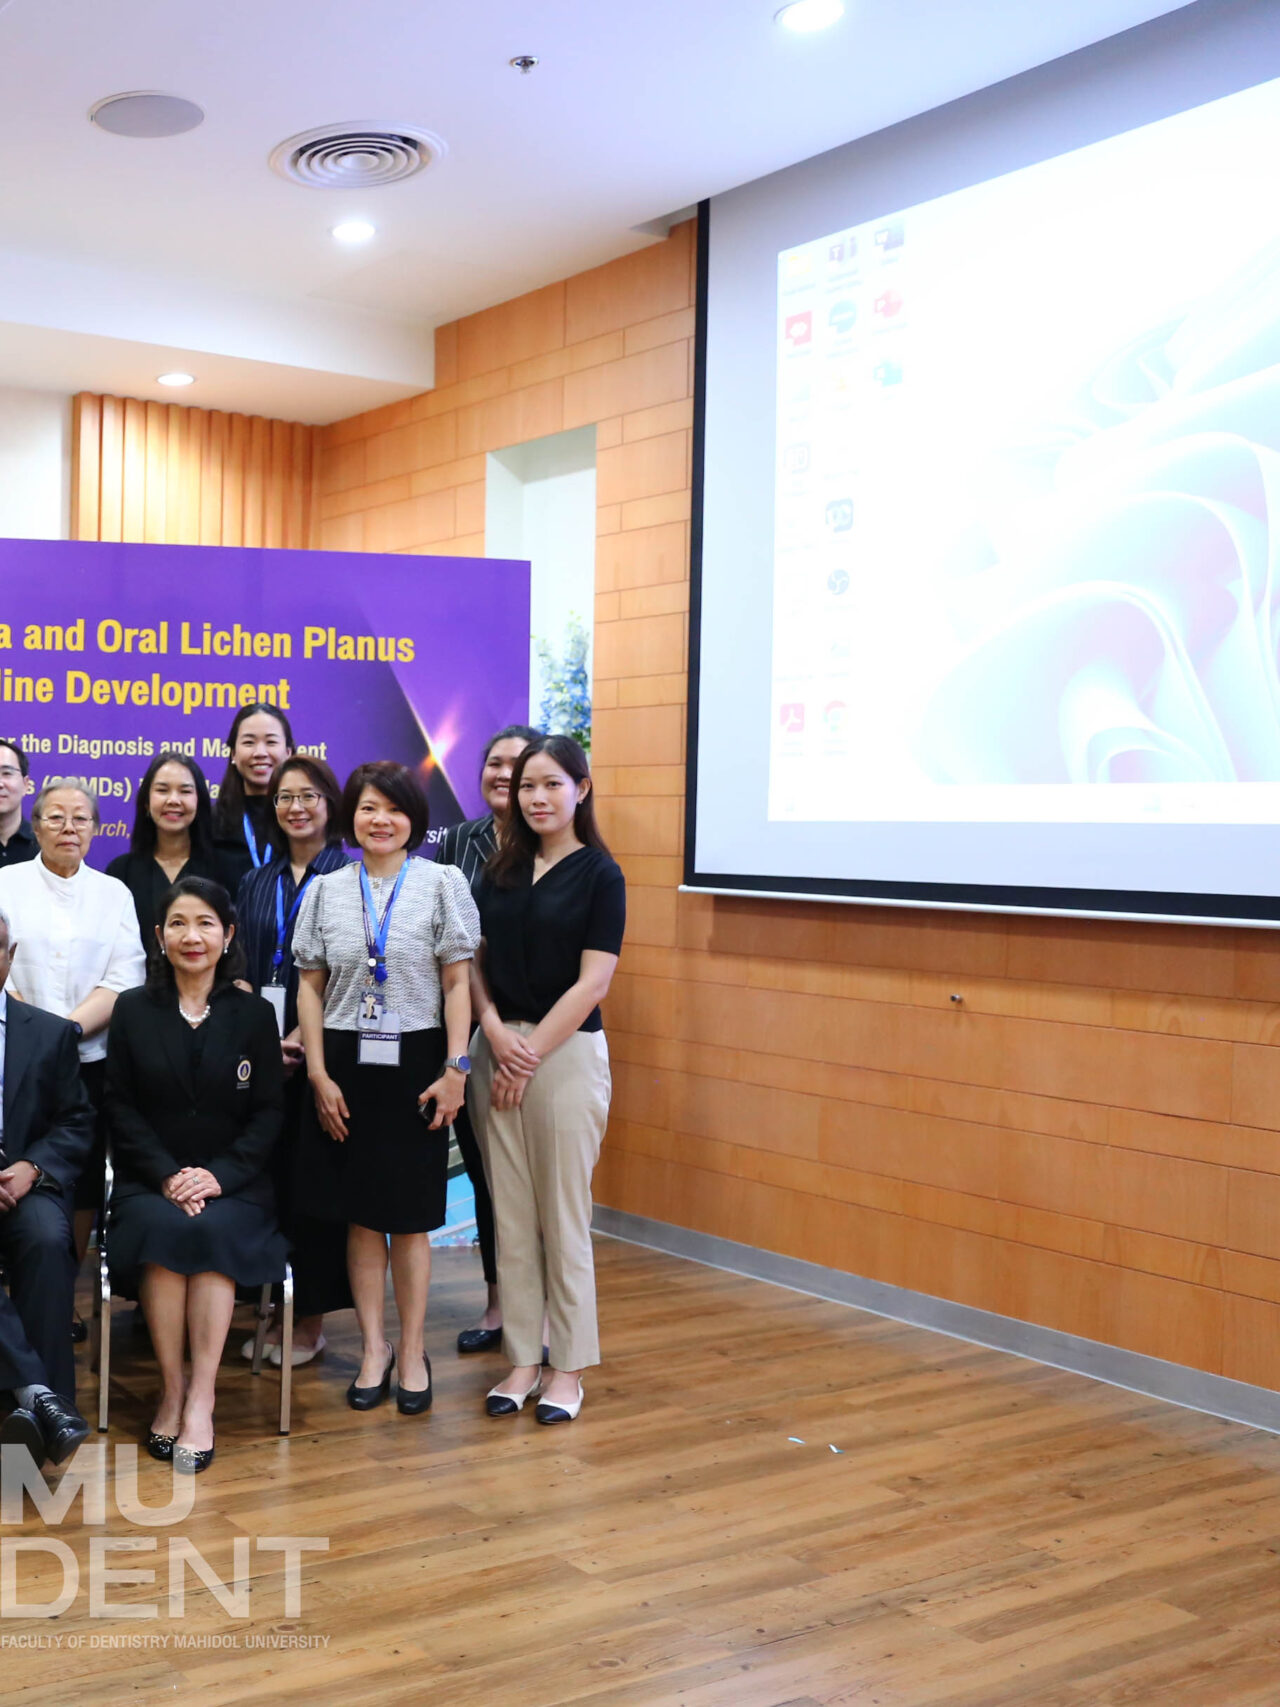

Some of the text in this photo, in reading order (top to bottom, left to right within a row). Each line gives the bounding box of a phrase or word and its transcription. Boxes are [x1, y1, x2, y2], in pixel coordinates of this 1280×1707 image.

[23, 619, 85, 651] and
[97, 619, 168, 654] Oral
[180, 622, 292, 658] Lichen
[303, 626, 415, 662] Planus
[66, 670, 290, 715] Development
[22, 734, 51, 753] the
[58, 734, 154, 759] Diagnosis
[160, 737, 196, 757] and
